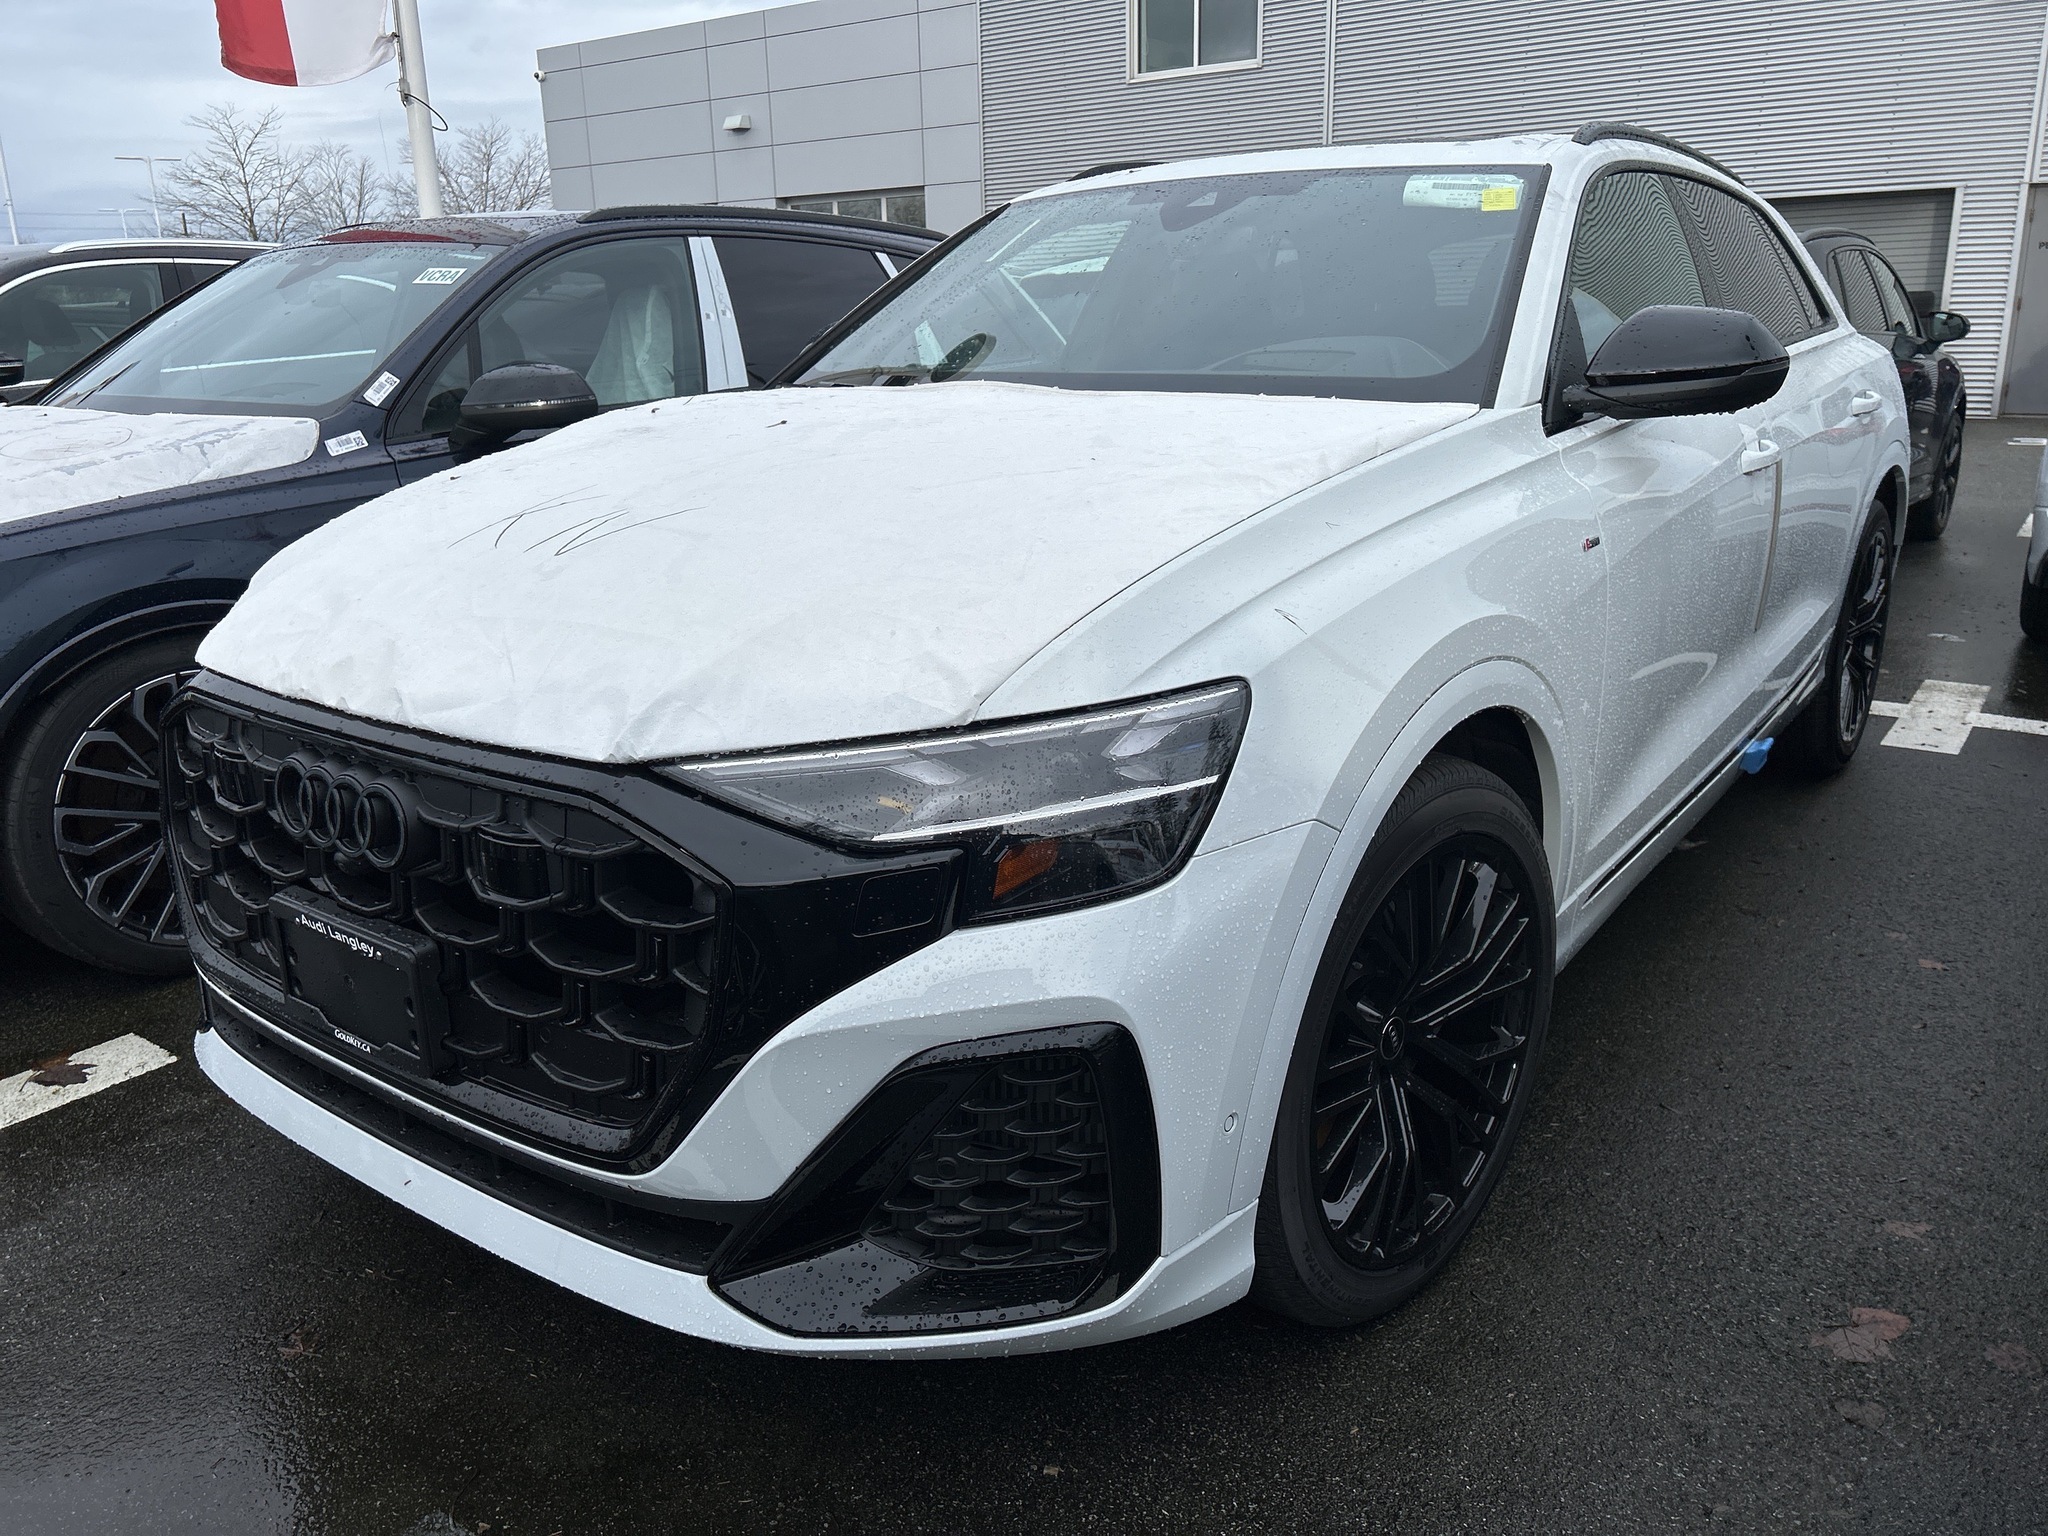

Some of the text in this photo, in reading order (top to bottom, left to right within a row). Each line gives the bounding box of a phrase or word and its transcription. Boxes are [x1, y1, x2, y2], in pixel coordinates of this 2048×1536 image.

[419, 270, 461, 281] VCRA
[301, 914, 374, 957] Audi Langley
